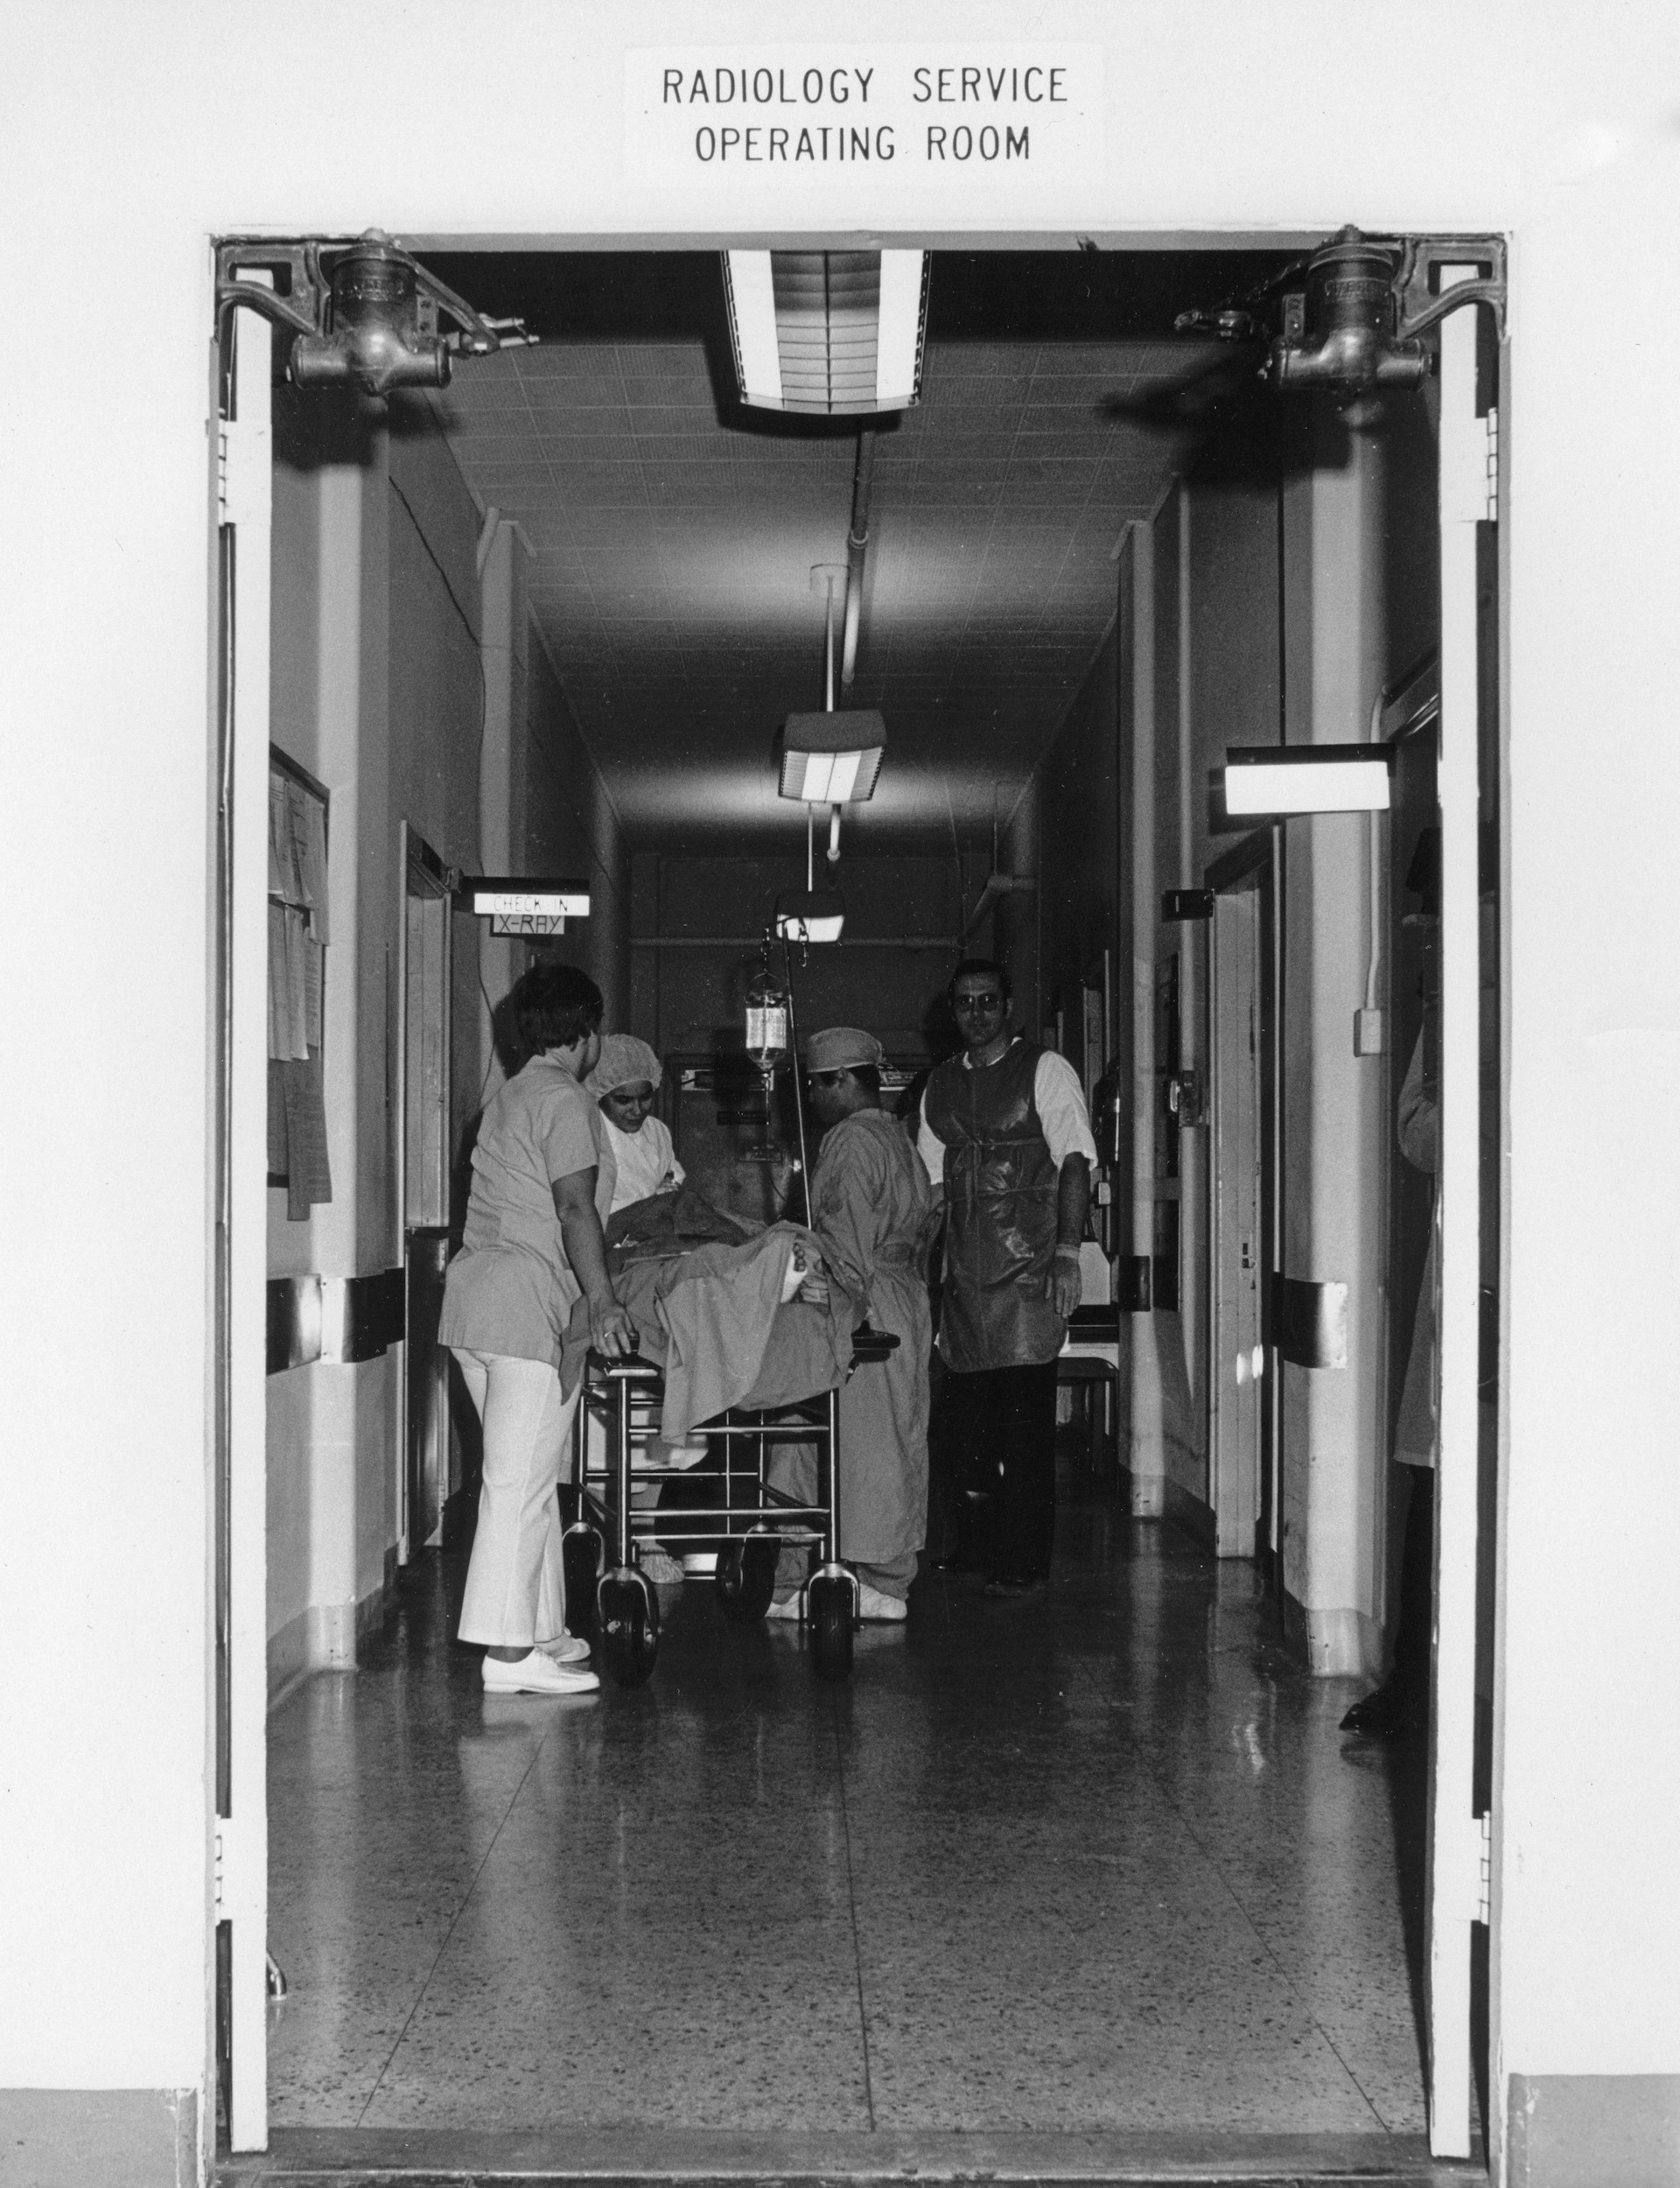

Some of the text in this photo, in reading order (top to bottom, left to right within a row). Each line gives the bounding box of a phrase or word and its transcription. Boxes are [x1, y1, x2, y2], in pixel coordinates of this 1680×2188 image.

[662, 67, 1068, 104] RADIOLOGY SERVICE
[695, 125, 1030, 162] OPERATING ROOM
[494, 895, 542, 912] CHECK
[499, 915, 562, 934] X-RAY
